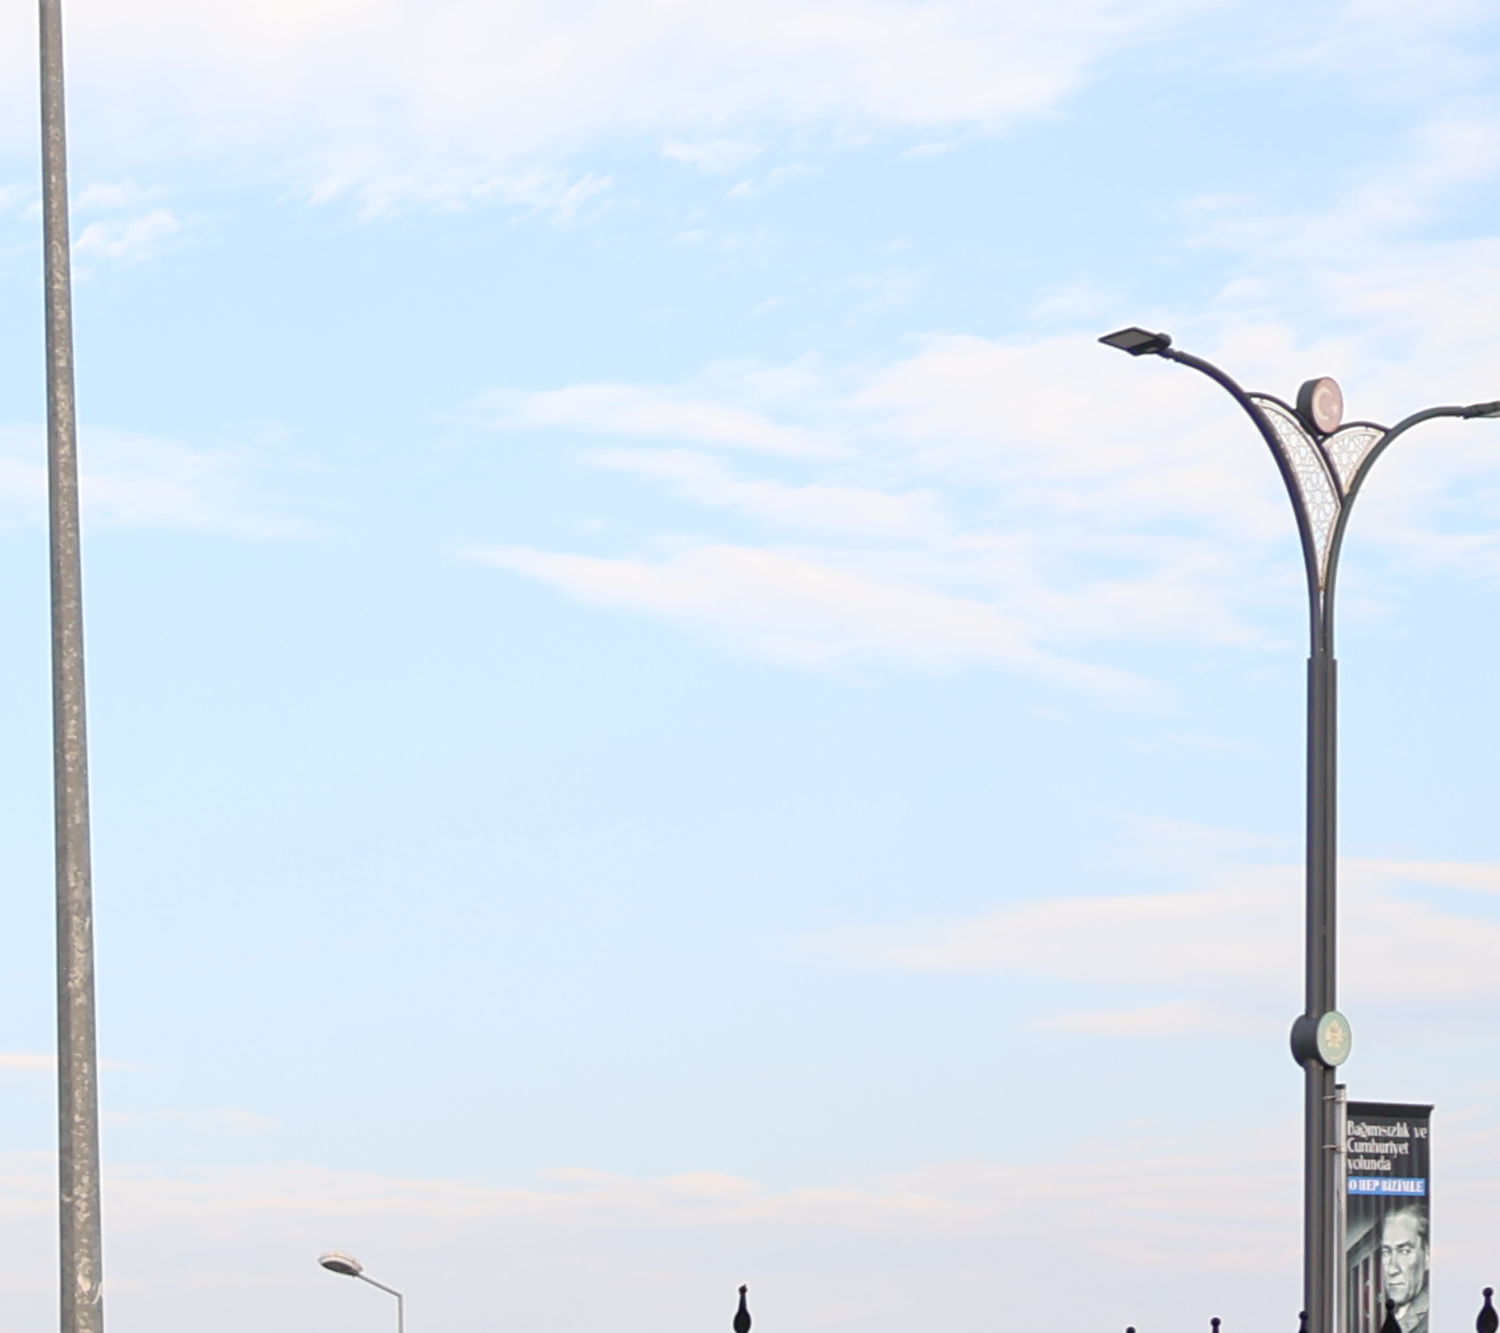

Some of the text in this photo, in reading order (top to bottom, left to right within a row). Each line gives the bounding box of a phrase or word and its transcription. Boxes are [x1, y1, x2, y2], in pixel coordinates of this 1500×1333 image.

[1413, 1127, 1428, 1138] ve
[1347, 1138, 1409, 1158] Cumhuriyet
[1347, 1155, 1392, 1174] yolunda
[1348, 1179, 1357, 1190] O
